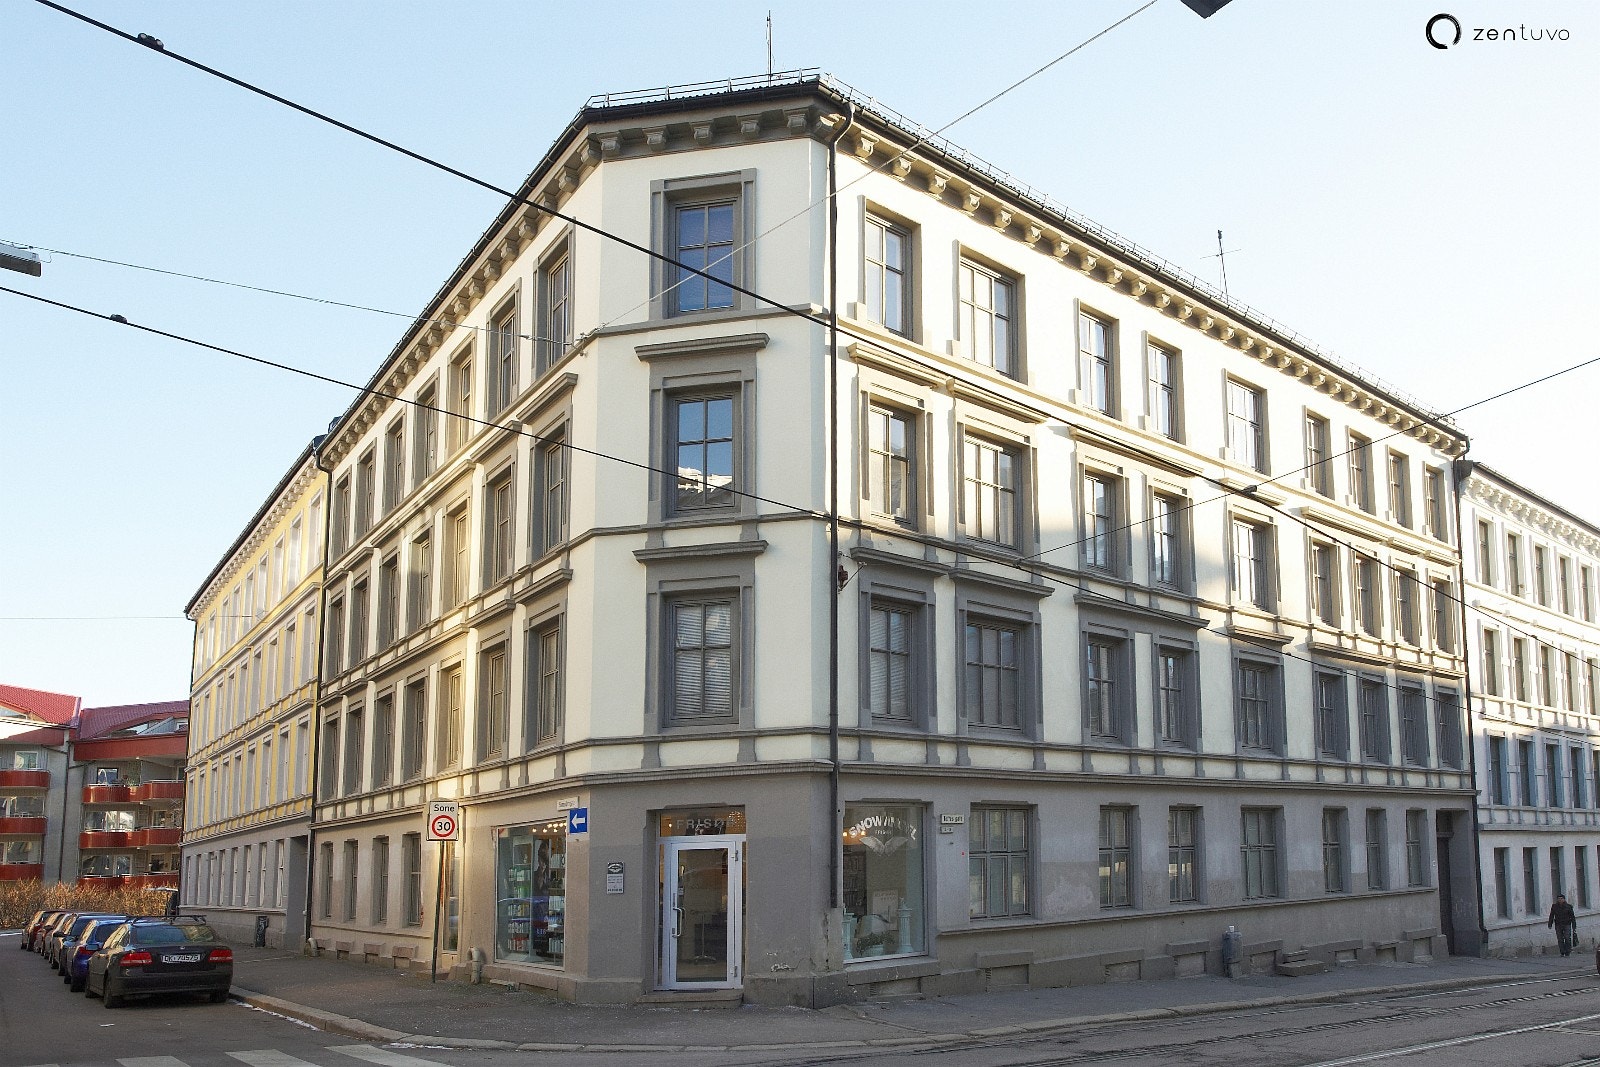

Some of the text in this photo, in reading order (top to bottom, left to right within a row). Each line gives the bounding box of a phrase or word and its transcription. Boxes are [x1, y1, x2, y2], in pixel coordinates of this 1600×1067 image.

[433, 803, 455, 812] Sone
[437, 821, 451, 831] 30
[849, 815, 882, 838] SNOW
